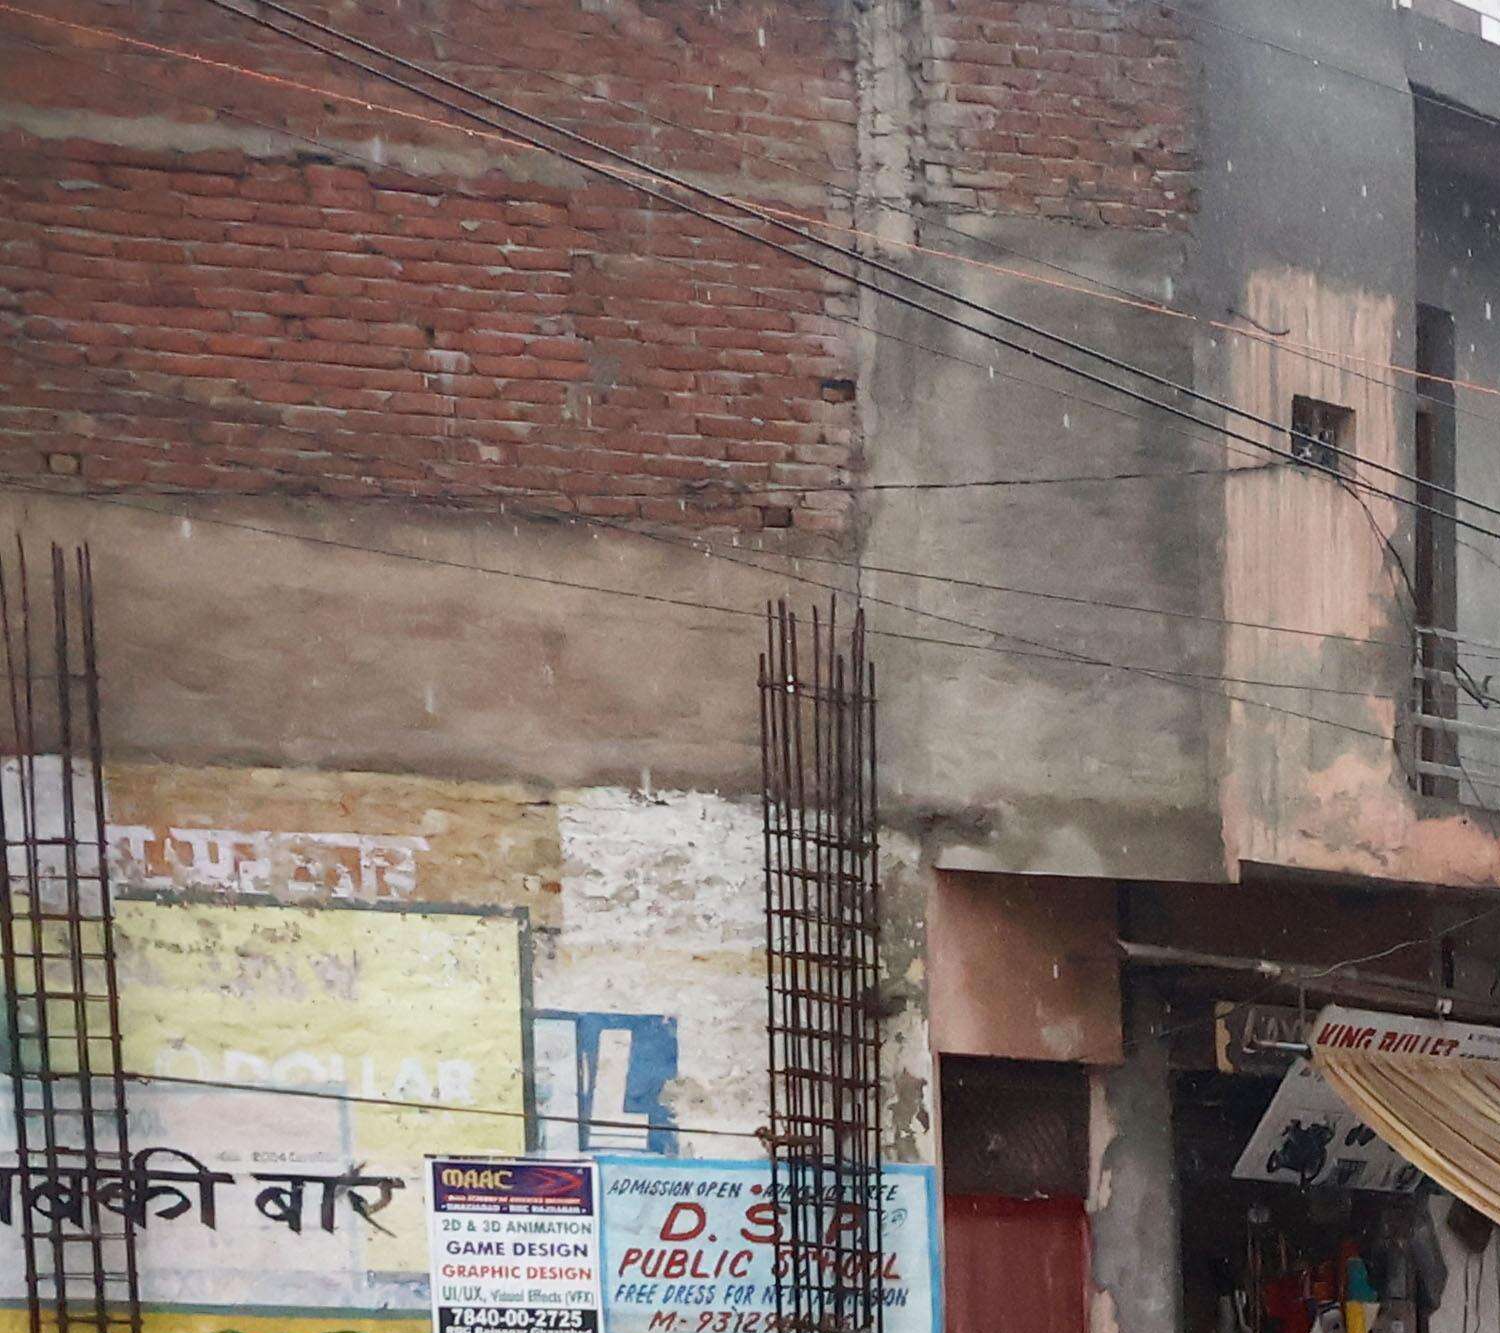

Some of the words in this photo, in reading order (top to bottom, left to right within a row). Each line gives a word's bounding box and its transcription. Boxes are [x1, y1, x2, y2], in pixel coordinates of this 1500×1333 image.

[441, 1168, 514, 1190] MAAC
[608, 1180, 690, 1197] ADMISSION
[698, 1182, 743, 1197] OPEN
[250, 1163, 407, 1239] बार
[442, 1219, 461, 1232] 2D
[467, 1219, 476, 1232] &
[483, 1220, 501, 1232] 3D
[506, 1220, 592, 1235] ANIMATION
[446, 1241, 505, 1256] GAME
[513, 1242, 589, 1258] DESIGN
[442, 1264, 521, 1279] GRAPHIC
[526, 1265, 593, 1281] DESIGN
[619, 1248, 753, 1279] PUBLIC
[615, 1284, 656, 1304] FREE
[663, 1285, 716, 1304] DRESS
[724, 1285, 755, 1304] FOR
[451, 1309, 583, 1328] 7840-00-2725
